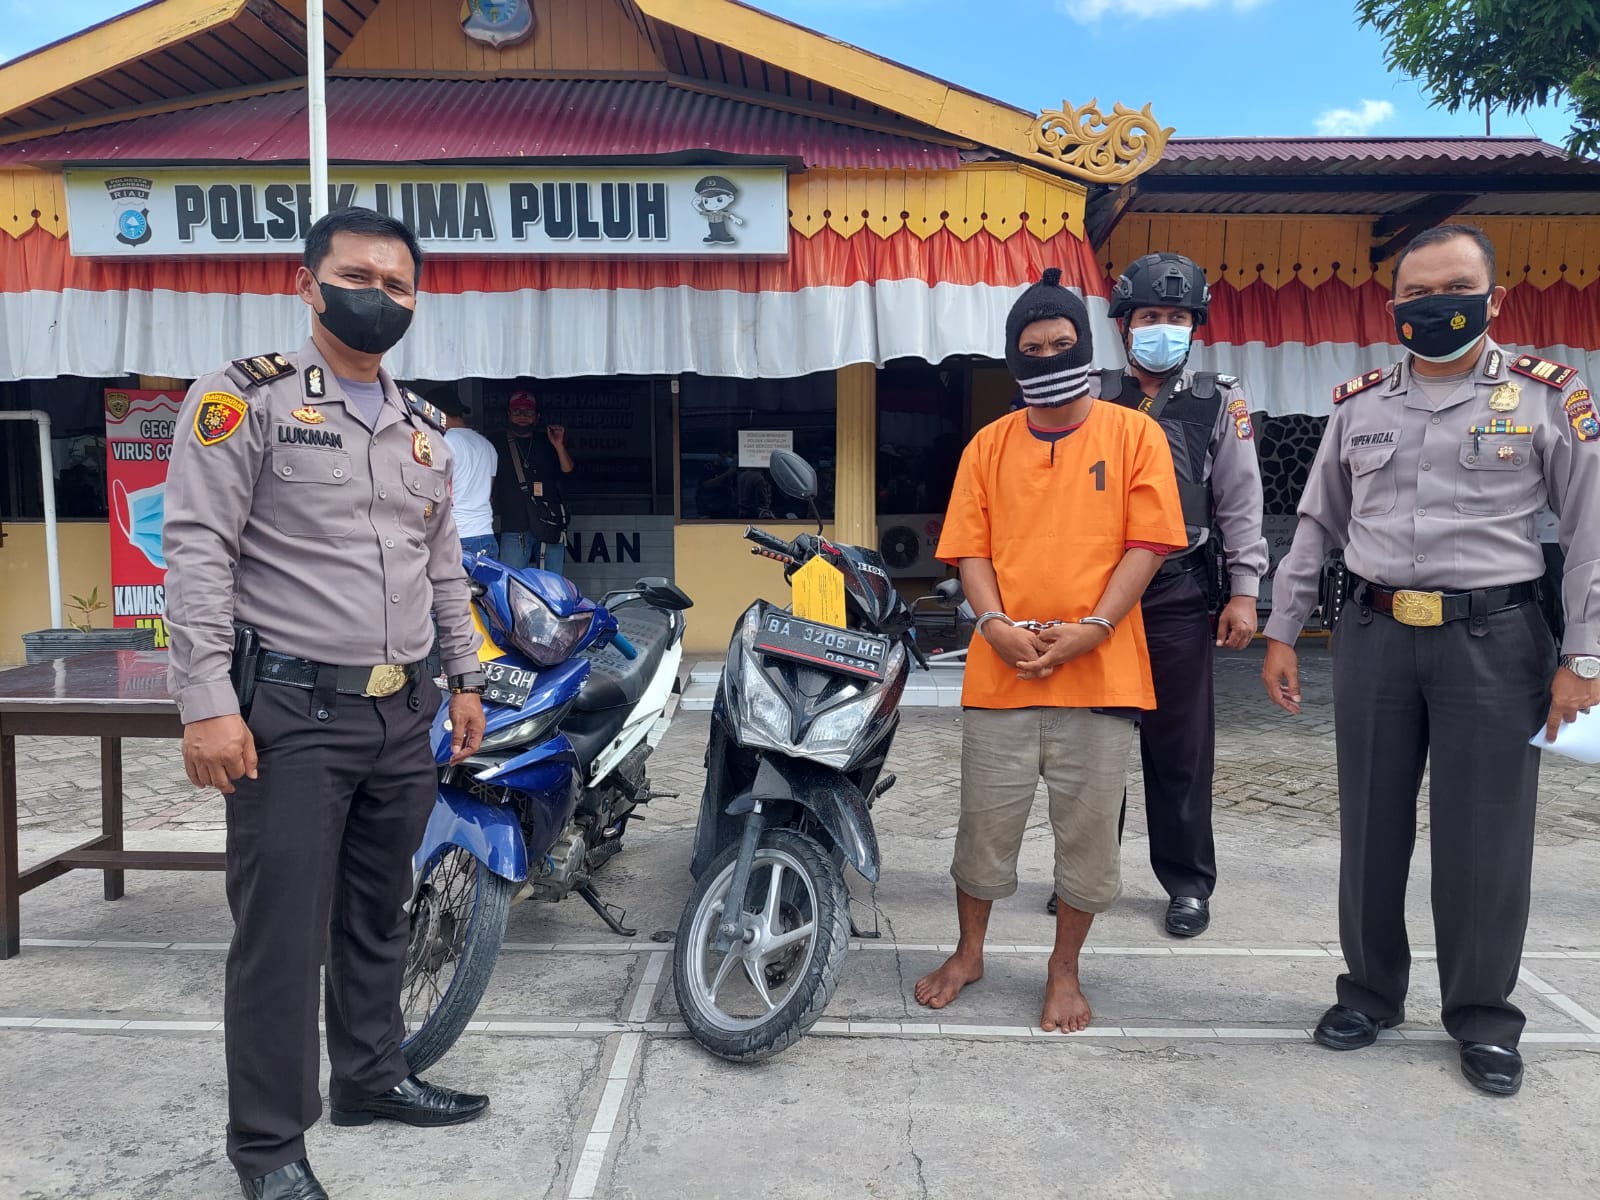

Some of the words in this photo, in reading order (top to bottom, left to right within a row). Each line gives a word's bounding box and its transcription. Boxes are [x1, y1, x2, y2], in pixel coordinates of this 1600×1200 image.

[113, 190, 146, 199] RIAU
[509, 182, 669, 240] PULUH
[278, 424, 343, 449] LUKMAN
[1370, 431, 1394, 445] RIZAL
[112, 442, 153, 460] VIRUS
[1088, 460, 1106, 491] 1
[768, 619, 790, 636] BA
[803, 628, 847, 649] 3206
[508, 669, 538, 689] QH
